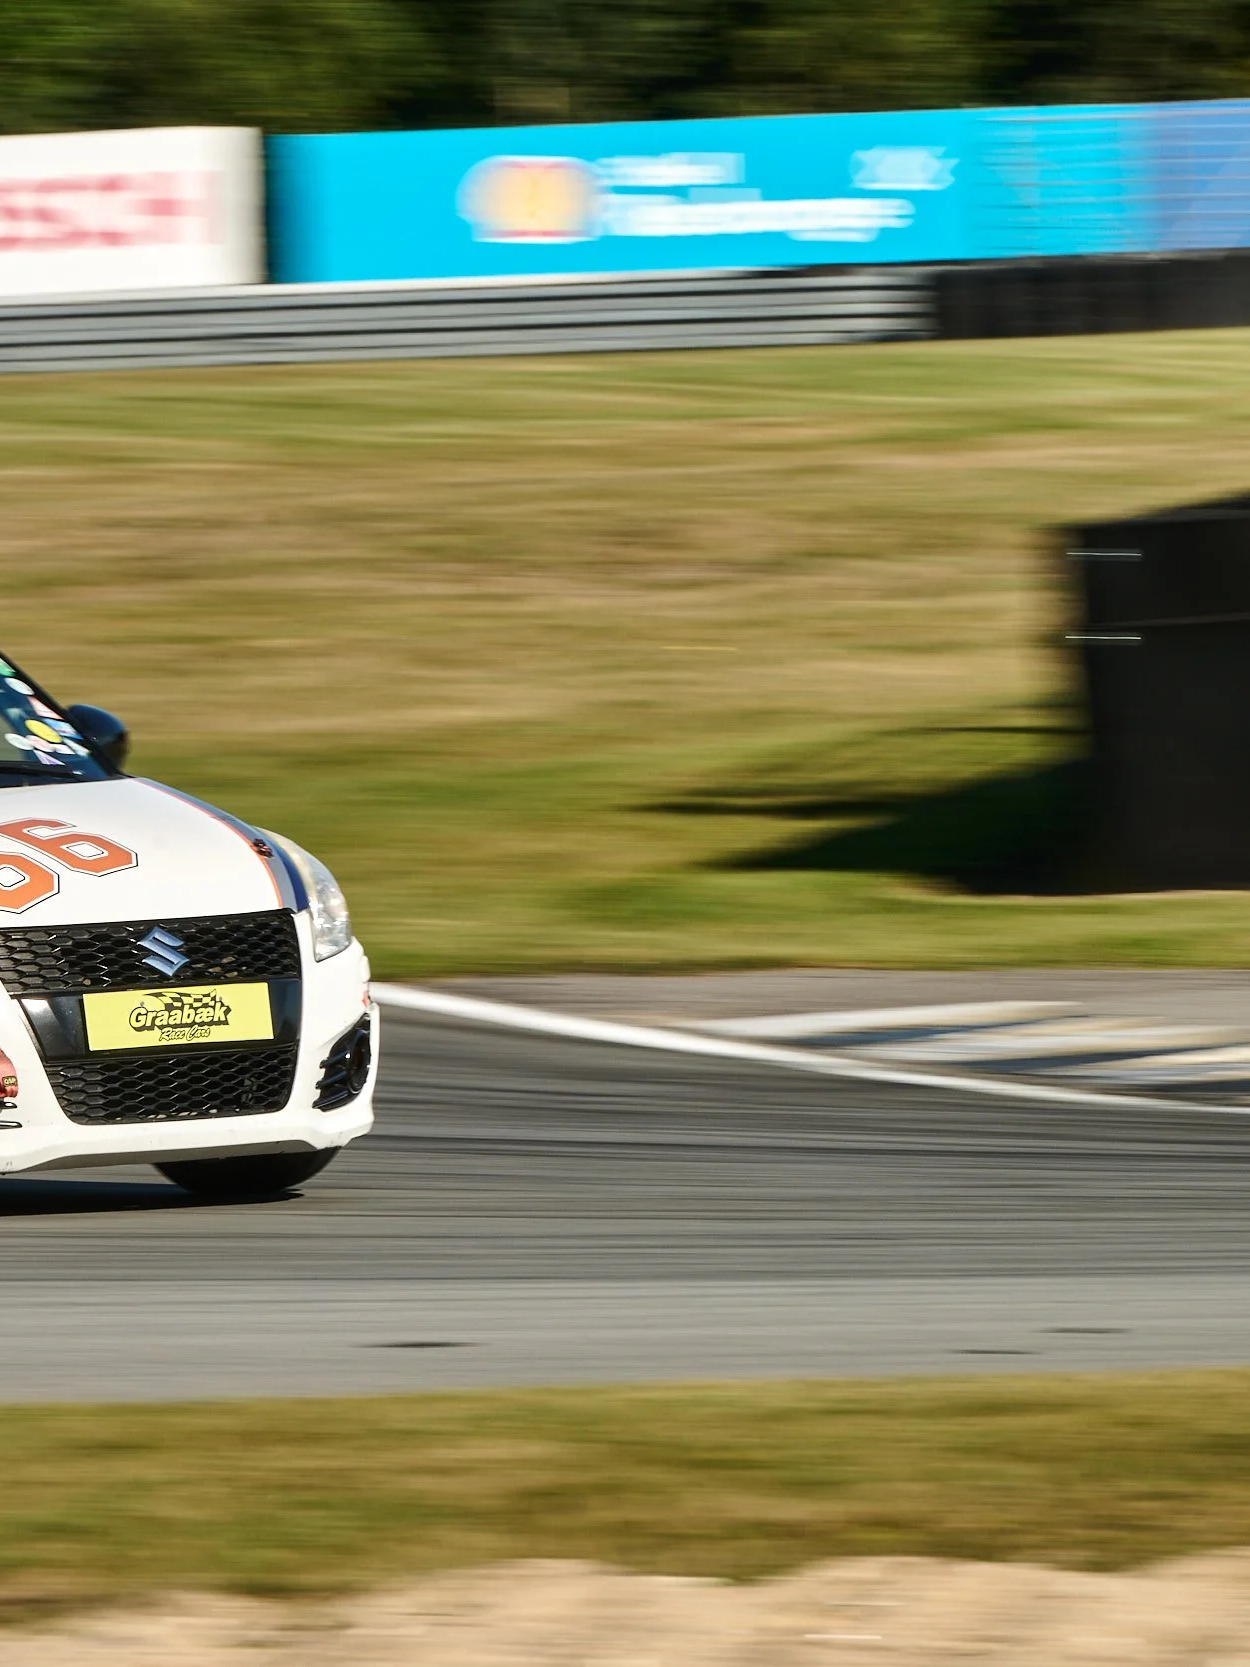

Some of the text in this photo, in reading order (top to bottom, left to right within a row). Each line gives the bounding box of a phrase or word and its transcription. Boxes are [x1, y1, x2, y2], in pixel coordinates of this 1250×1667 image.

[129, 1003, 232, 1032] Graabæk
[159, 1025, 211, 1042] Race Cars
